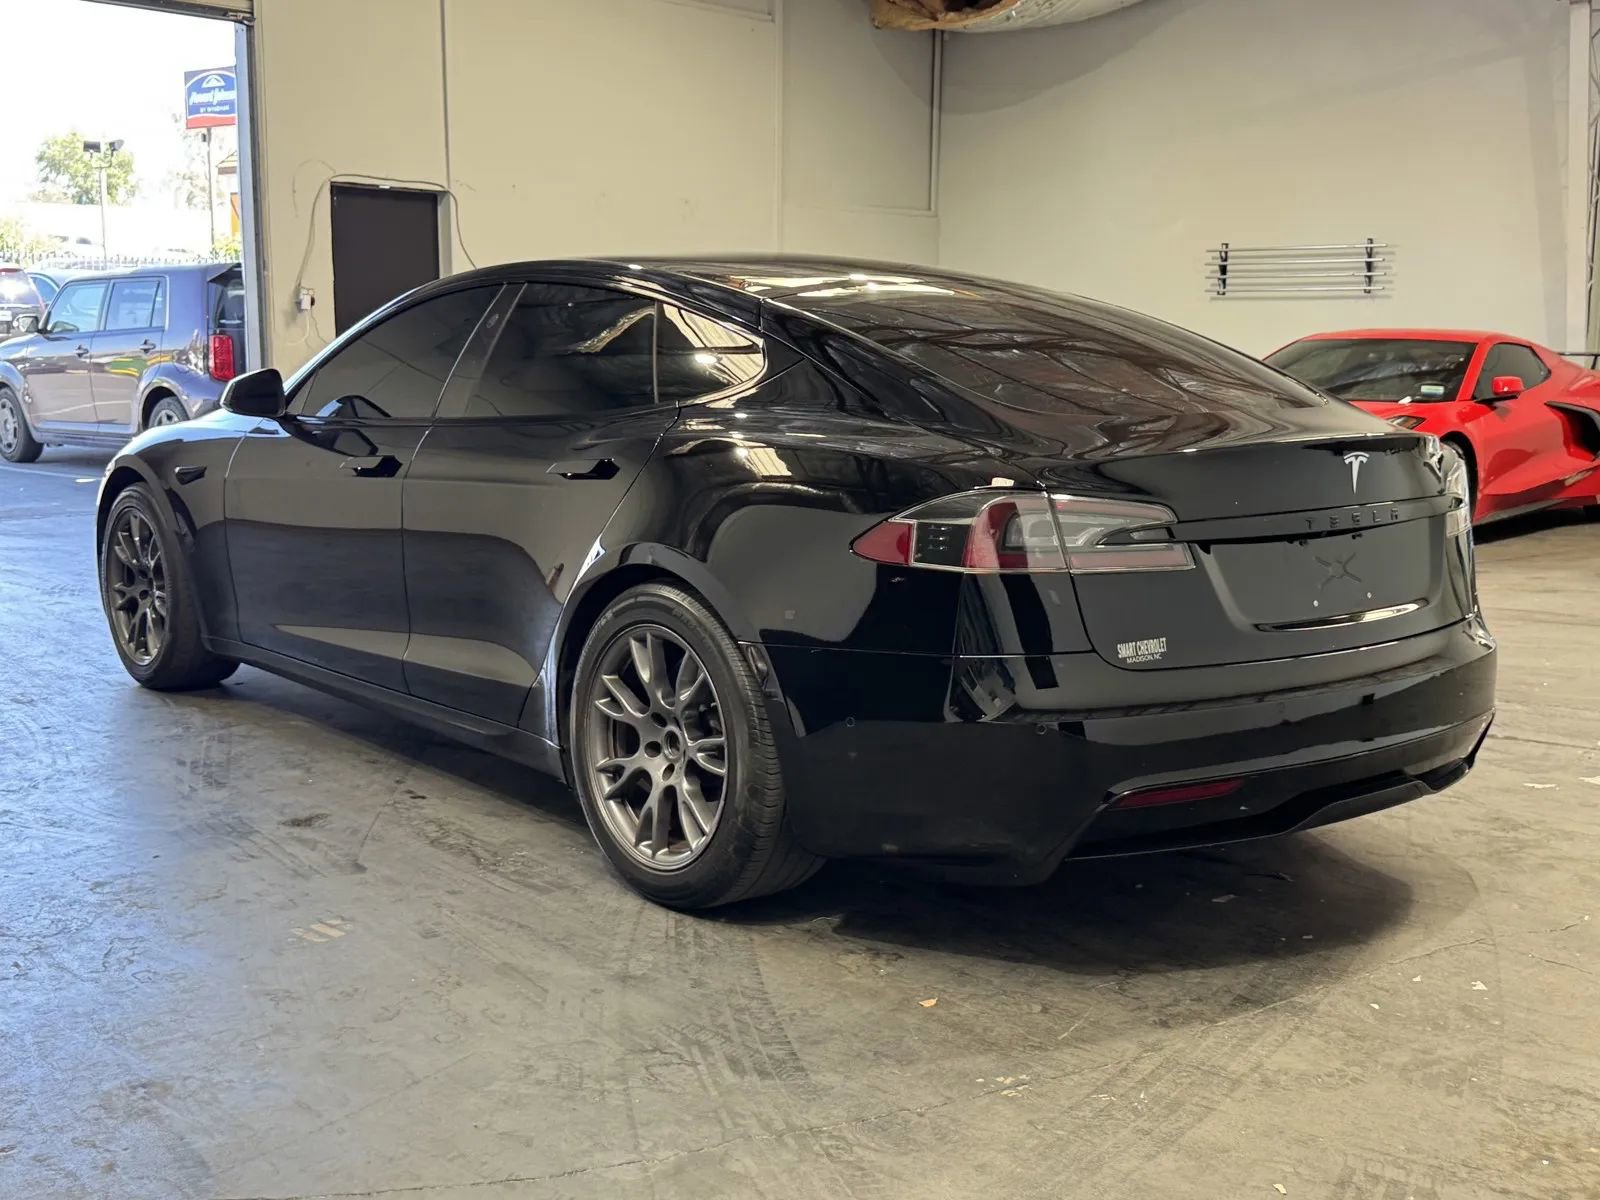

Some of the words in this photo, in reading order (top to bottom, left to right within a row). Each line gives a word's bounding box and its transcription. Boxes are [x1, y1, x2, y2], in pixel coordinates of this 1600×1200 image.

[1305, 508, 1399, 529] TESLA
[1117, 642, 1136, 658] SMART
[1137, 637, 1166, 655] CHEVROLET
